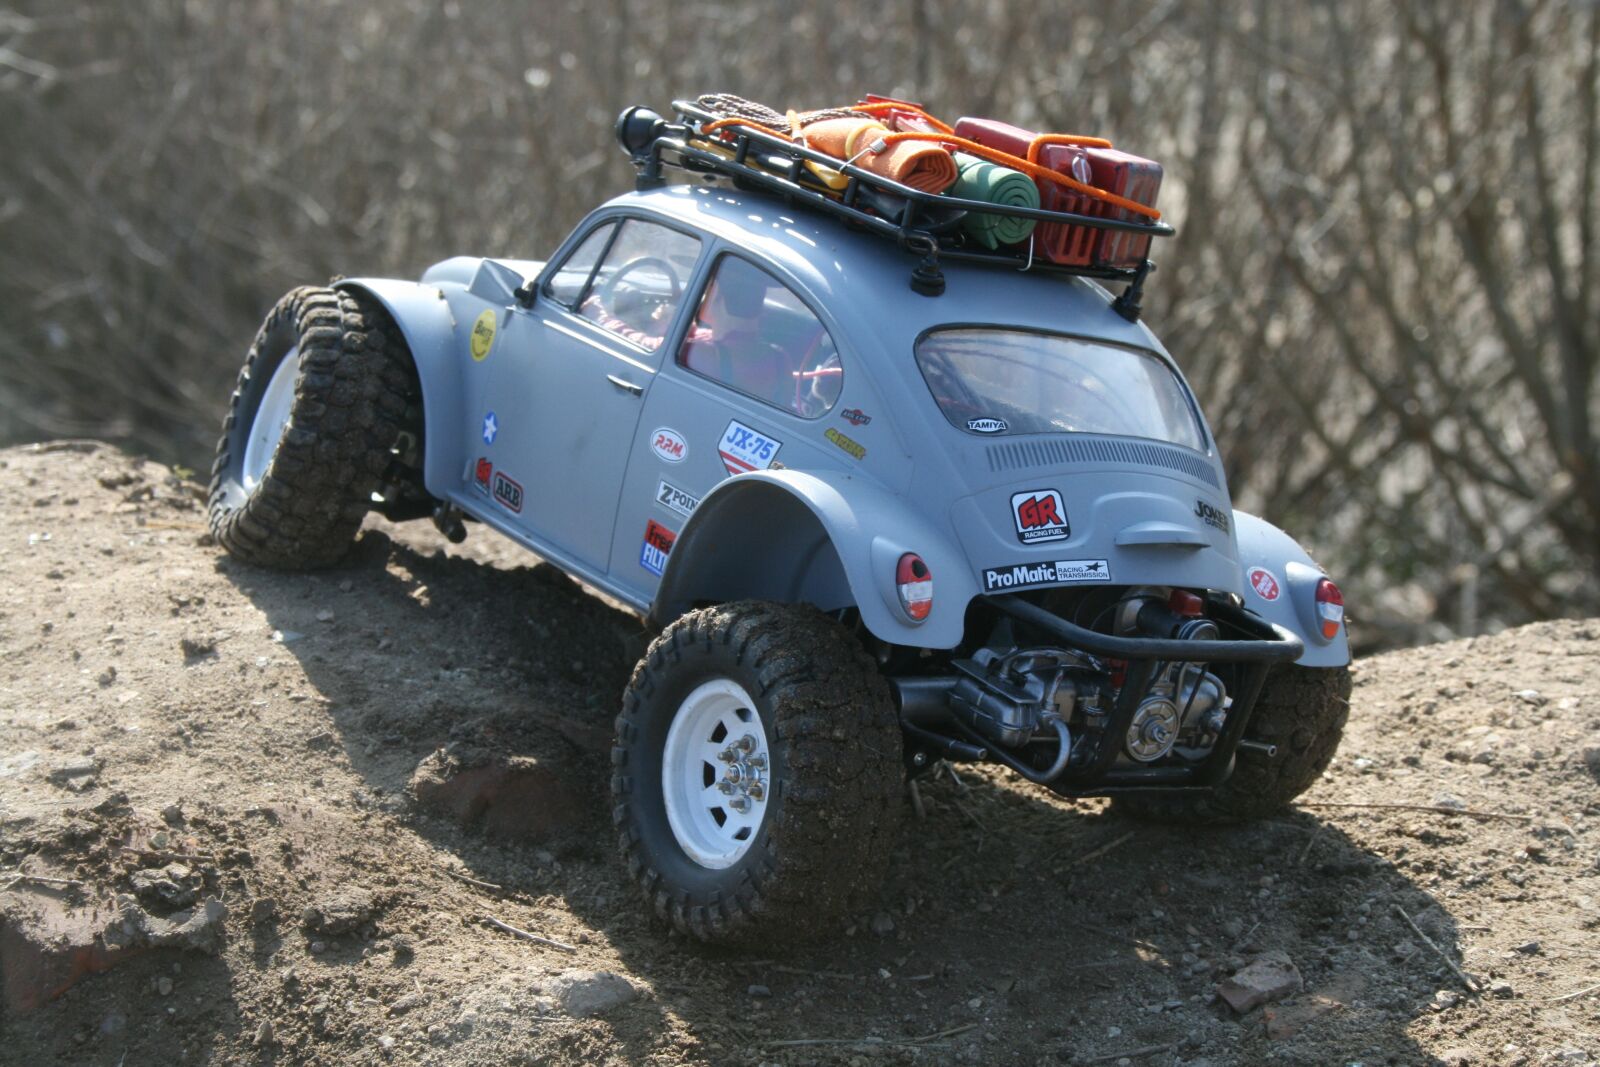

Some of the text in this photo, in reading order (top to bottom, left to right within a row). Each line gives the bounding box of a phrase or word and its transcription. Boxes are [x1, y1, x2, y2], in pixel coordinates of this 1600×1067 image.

[969, 421, 1006, 430] TAMIYA
[495, 478, 520, 507] ARB
[1018, 495, 1064, 529] GR
[1024, 528, 1064, 538] RACING FUEL
[642, 543, 669, 571] FILT
[986, 564, 1057, 589] ProMatic
[1059, 572, 1108, 580] TRANSMISSION
